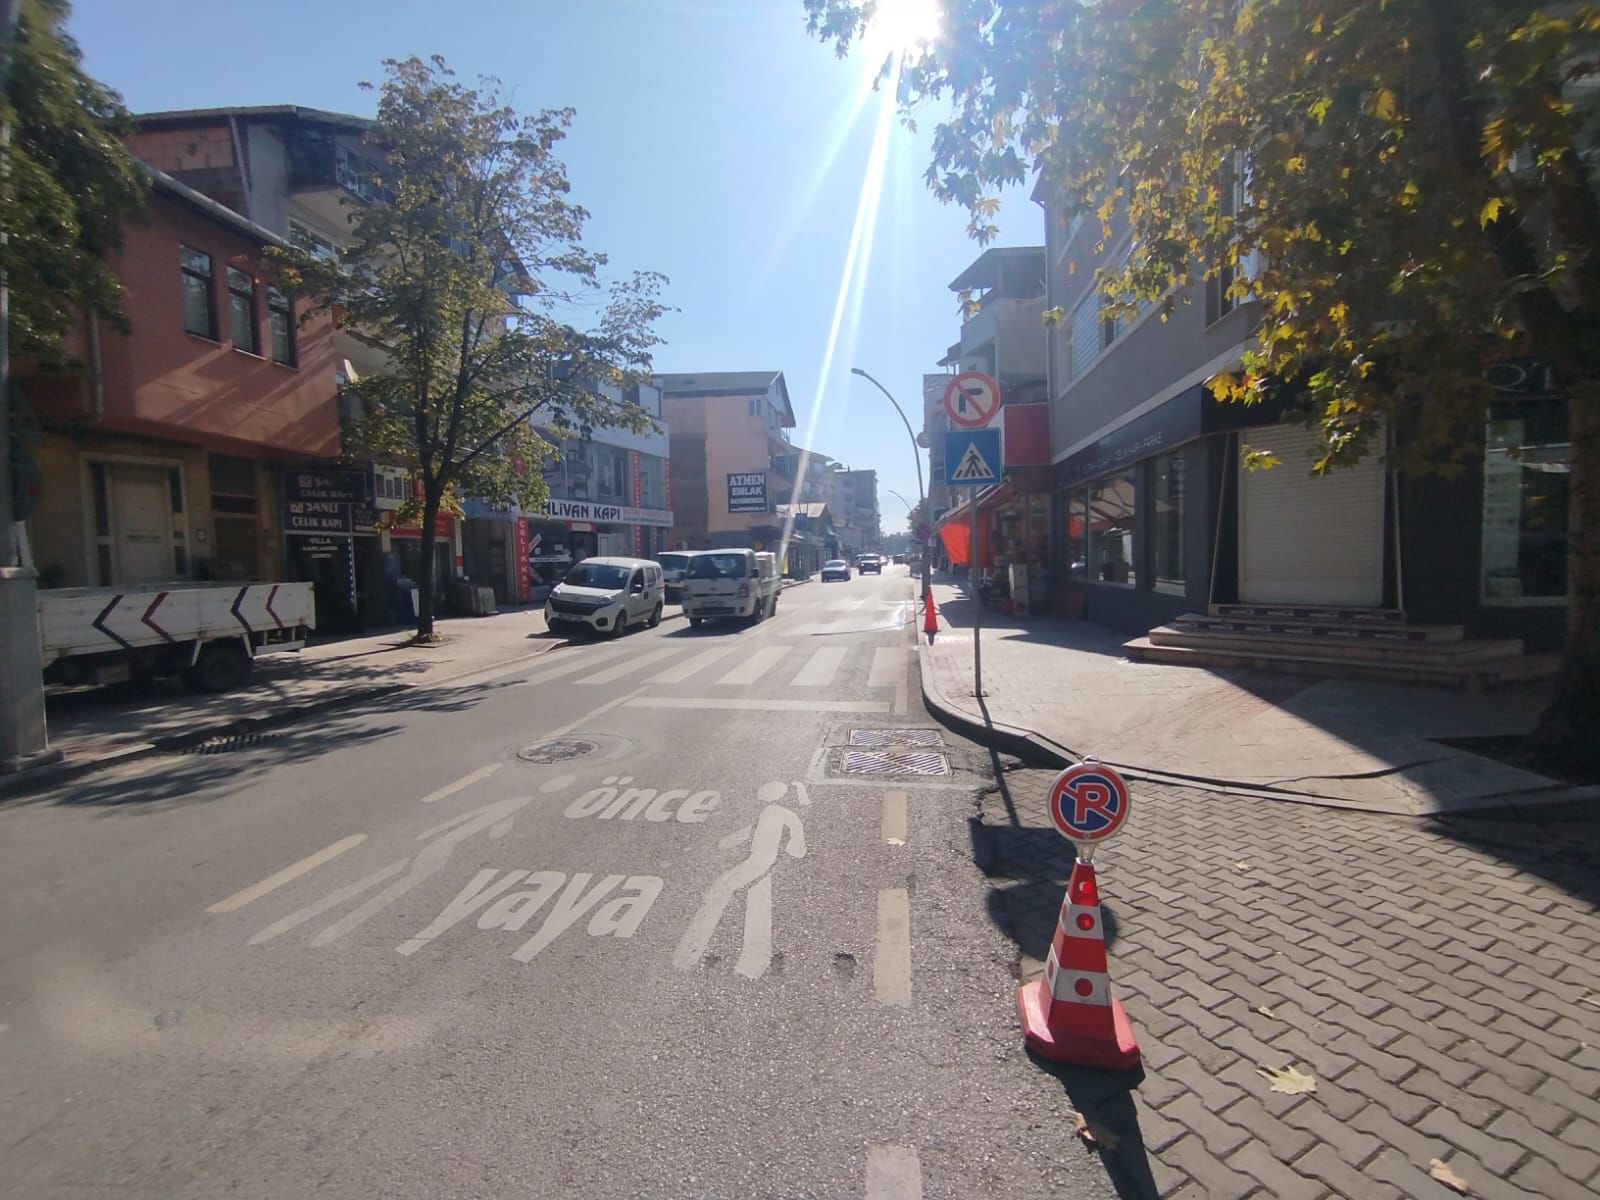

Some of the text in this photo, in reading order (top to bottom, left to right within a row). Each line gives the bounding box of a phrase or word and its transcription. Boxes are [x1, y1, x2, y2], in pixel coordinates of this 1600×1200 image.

[729, 475, 765, 486] AYMEN
[731, 486, 763, 496] EMLAK
[594, 506, 621, 520] KAPI
[563, 775, 723, 824] önce
[394, 868, 665, 964] yaya
